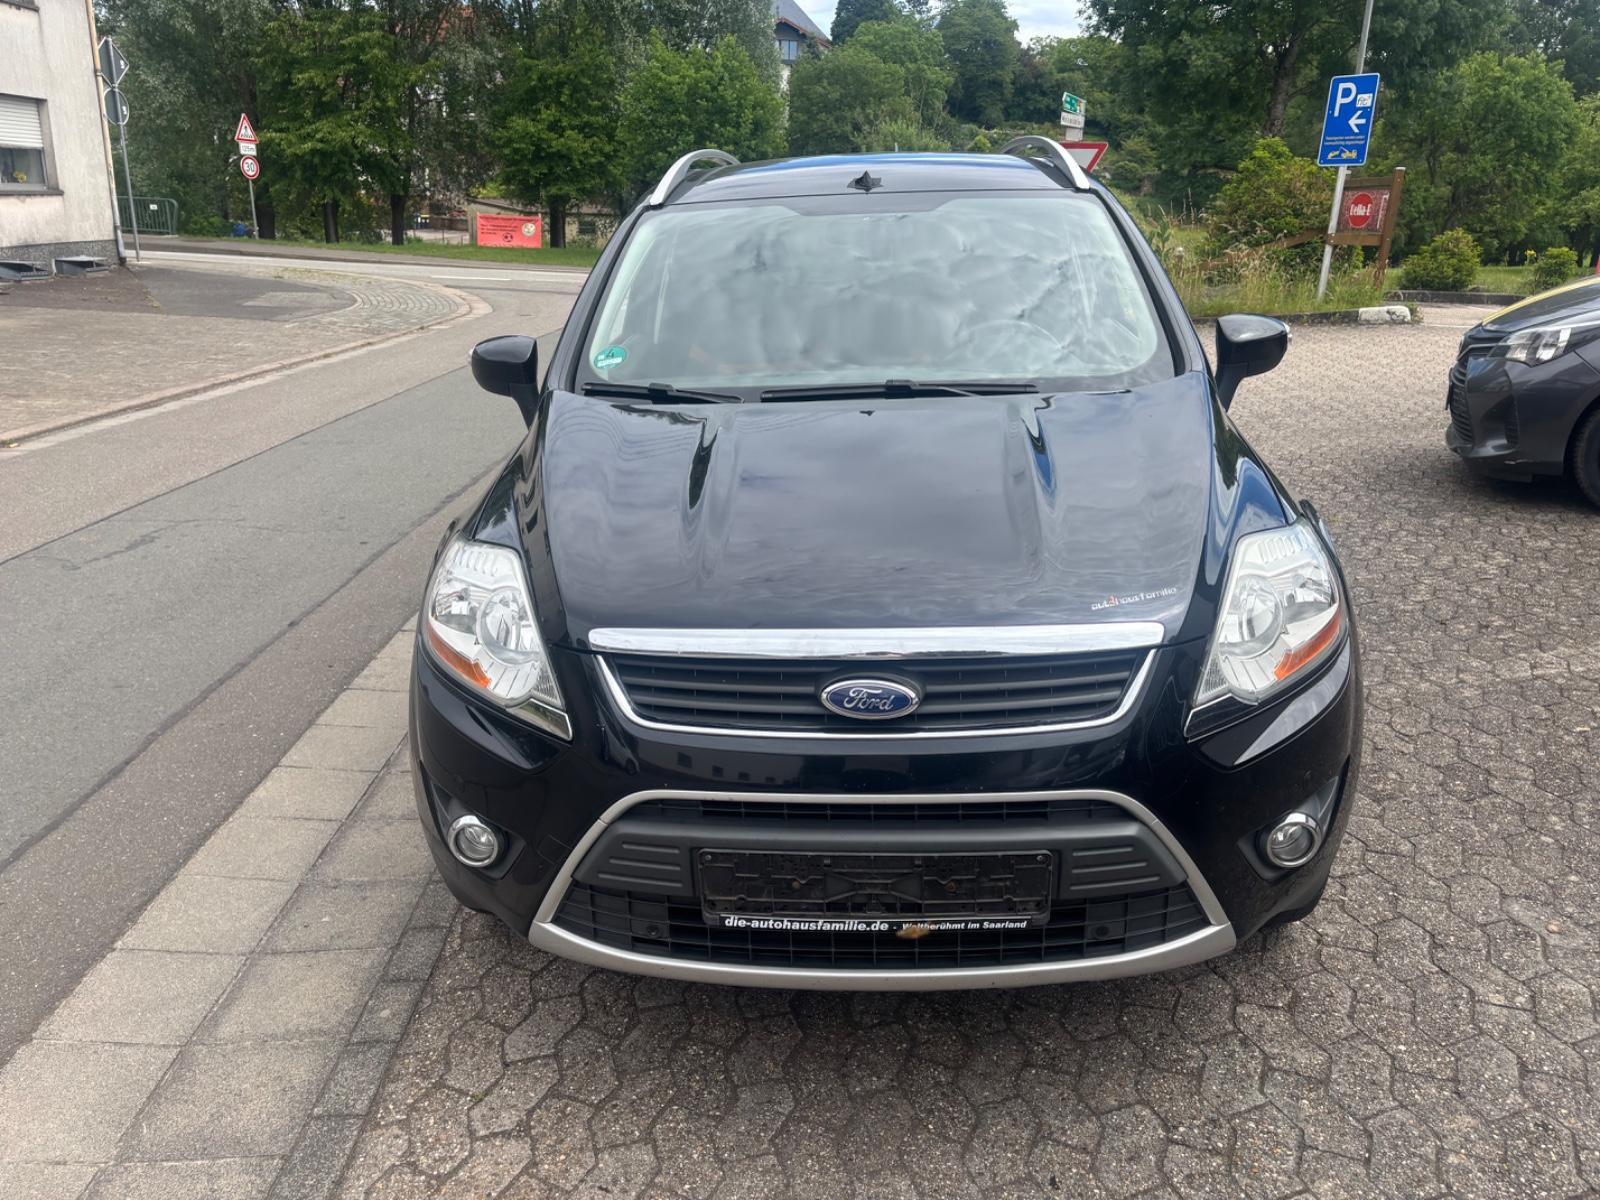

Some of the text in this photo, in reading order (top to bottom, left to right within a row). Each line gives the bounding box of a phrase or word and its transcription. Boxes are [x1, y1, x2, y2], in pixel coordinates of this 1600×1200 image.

[1333, 82, 1357, 117] P
[245, 161, 255, 172] 30
[843, 687, 895, 710] Ford
[724, 916, 889, 931] die-autohausfamilie.de
[967, 921, 980, 929] im
[982, 921, 1027, 929] Saarland
